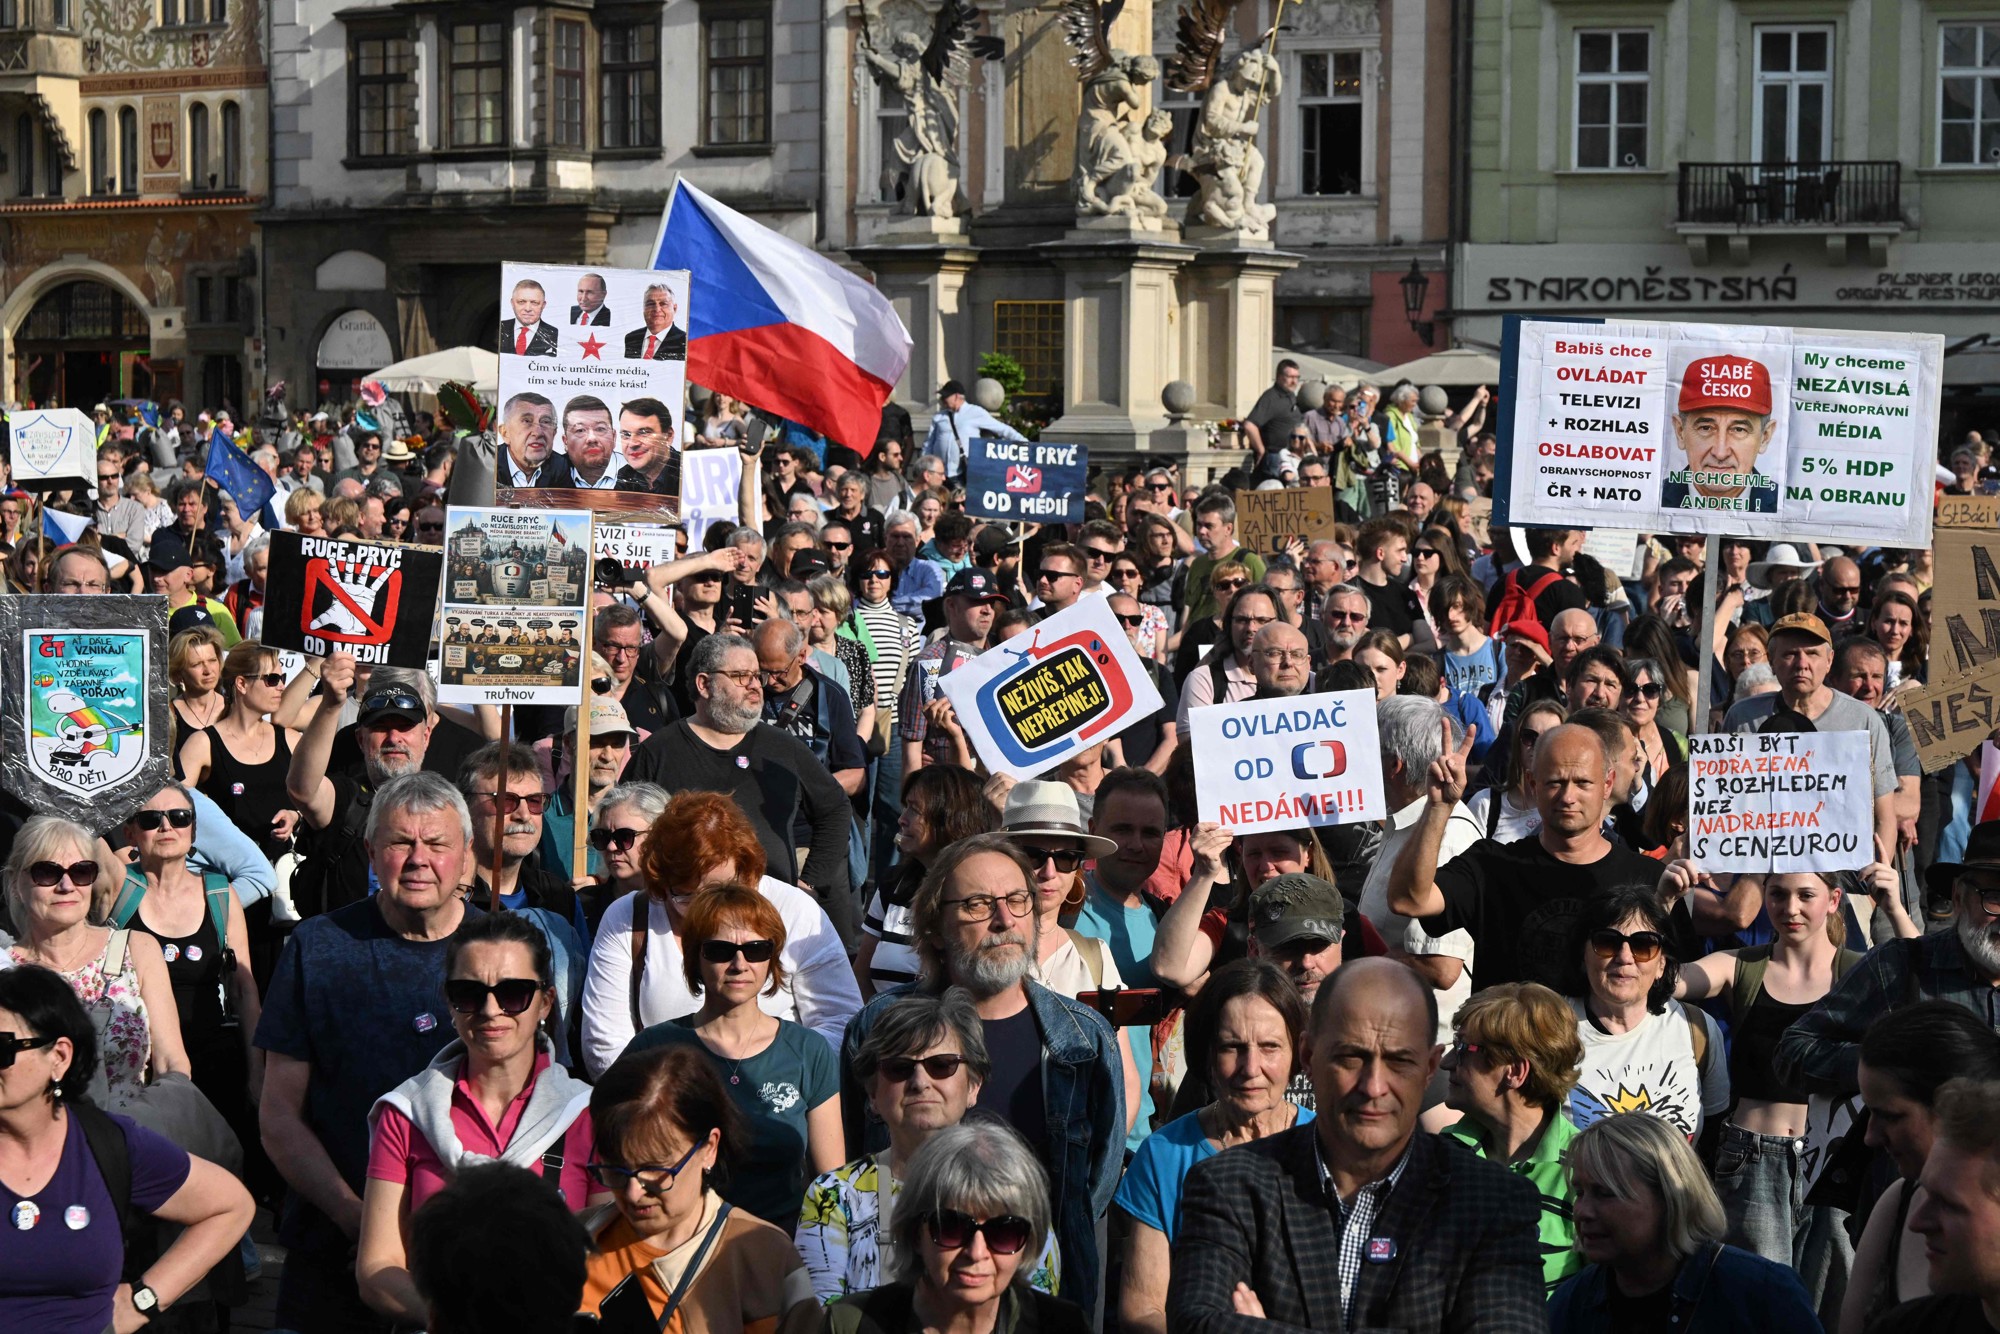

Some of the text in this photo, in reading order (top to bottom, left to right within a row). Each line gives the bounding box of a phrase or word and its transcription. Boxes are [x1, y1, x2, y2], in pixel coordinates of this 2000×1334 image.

[1488, 262, 1797, 302] STAROMĚSTSKÁ
[1877, 272, 1953, 286] PILSNER
[1836, 287, 1912, 300] ORIGINAL
[1555, 340, 1652, 358] Babiš chce
[528, 360, 650, 377] Čím víc umlčíme média,
[1700, 362, 1753, 380] SLABÉ
[1804, 353, 1906, 370] My chceme
[528, 376, 544, 384] tím
[561, 377, 586, 386] bude
[588, 378, 616, 388] snáze
[620, 379, 647, 388] krást!
[1556, 366, 1648, 384] OVLÁDAT
[1702, 380, 1752, 398] ČESKO
[1796, 376, 1910, 396] NEZÁVISLÁ
[1560, 393, 1640, 410] TELEVIZI
[1796, 400, 1909, 417] VEŘEJNOPRÁVNÍ
[1564, 418, 1649, 434] ROZHLAS
[1818, 420, 1882, 440] MÉDIA
[986, 442, 1078, 466] RUCE PRYČ
[1538, 442, 1656, 462] OSLABOVAT
[1540, 466, 1652, 479] OBRANYSCHOPNOST
[1846, 460, 1894, 477] HDP
[1669, 470, 1776, 491] NECHCEME,
[1242, 491, 1309, 512] TAHEJTE
[1547, 482, 1572, 498] ČR
[1594, 487, 1642, 502] NATO
[1786, 486, 1906, 506] NA OBRANU
[982, 490, 1072, 516] OD MÉDIÍ
[1680, 496, 1750, 510] ANDREI
[490, 515, 540, 524] RUCE PRYČ
[1244, 512, 1302, 534] ZA NITKY
[301, 538, 402, 568] RUCE PRYČ
[594, 542, 652, 557] LAS ŠIJE
[39, 635, 65, 658] ČT
[76, 642, 130, 655] VZNIKAJÍ
[304, 636, 326, 656] OD
[54, 656, 94, 668] VHODNÉ
[64, 677, 106, 688] ZÁBAVNÉ
[1002, 654, 1090, 716] NEŽIVÍŠ, TAK
[485, 691, 535, 700] TRUTNOV
[1016, 681, 1104, 742] NEPŘEPÍNEJ!
[1222, 700, 1347, 739] OVLADAČ
[1907, 682, 2000, 748] NES
[1688, 732, 1800, 755] RADŠI BÝT
[49, 765, 106, 785] PRO DĚTI
[1234, 758, 1274, 781] OD
[1694, 774, 1847, 797] S ROZHLEDEM
[1219, 788, 1364, 826] NEDÁME!!!
[1693, 796, 1734, 815] NEŽ
[1694, 832, 1858, 859] S CENZUROU
